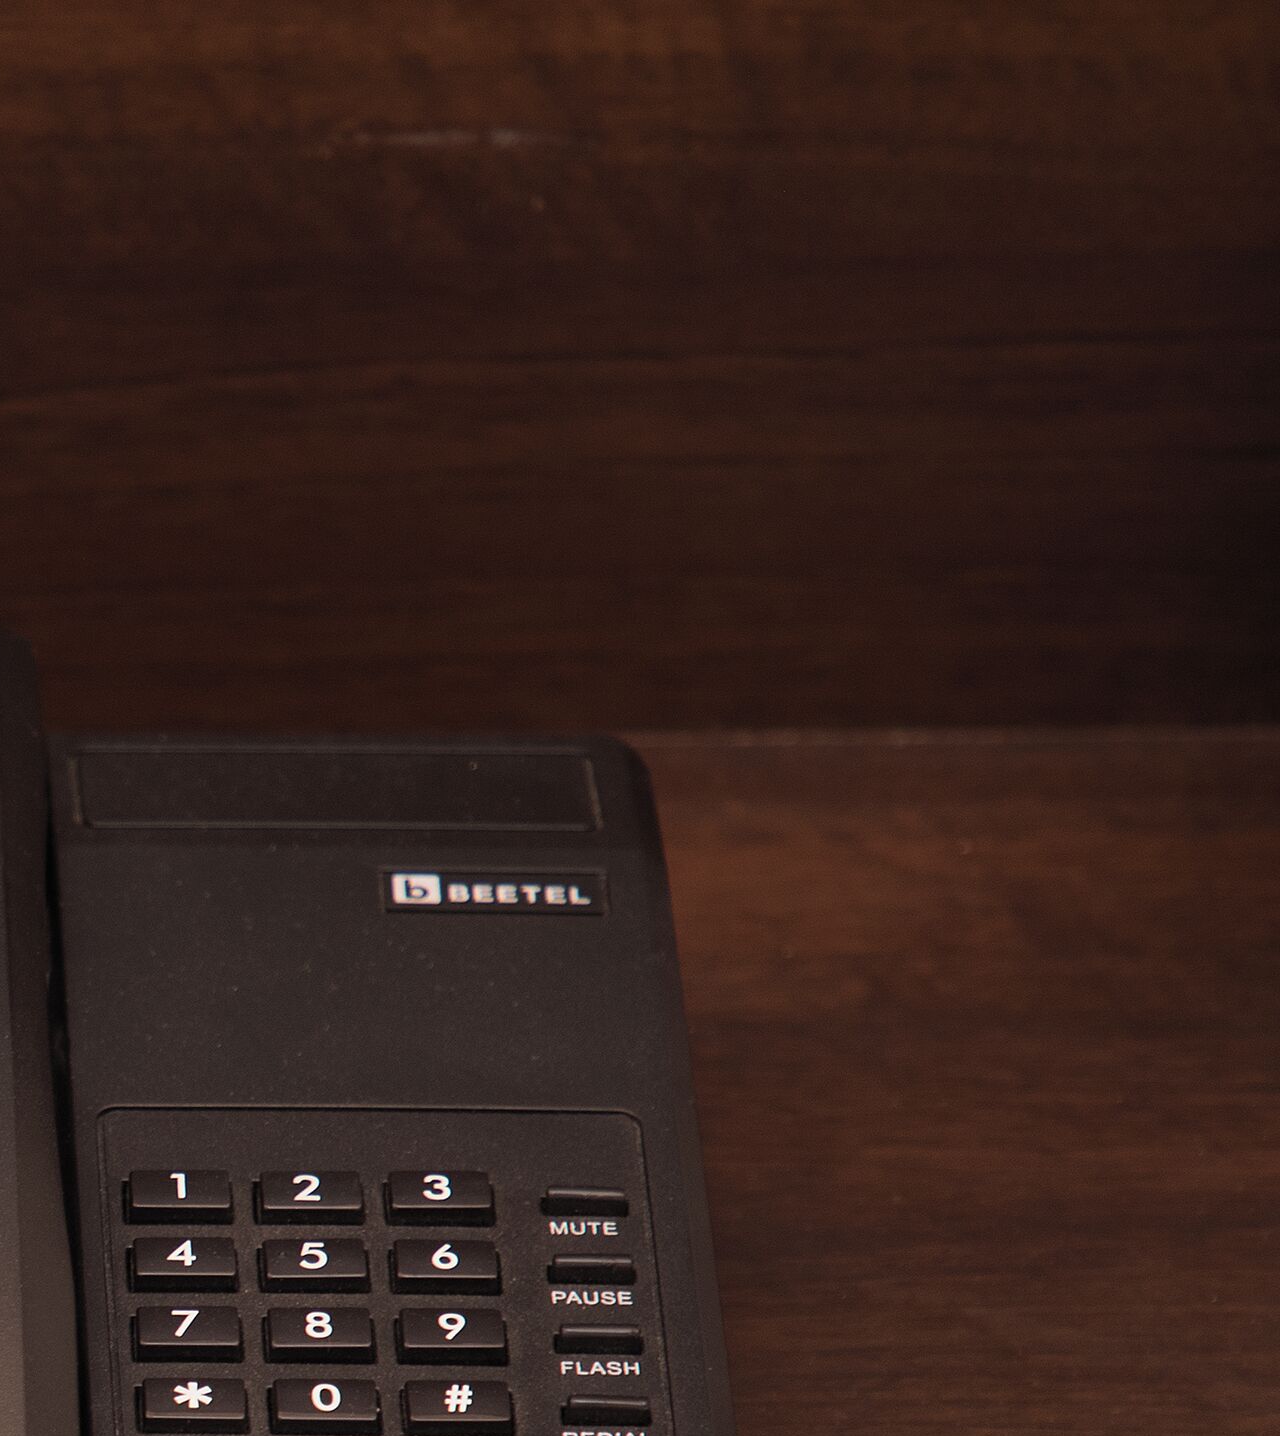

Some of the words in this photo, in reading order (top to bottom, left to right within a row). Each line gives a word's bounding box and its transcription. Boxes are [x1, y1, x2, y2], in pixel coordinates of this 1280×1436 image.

[447, 883, 591, 905] BEETEL
[169, 1172, 188, 1200] 1
[292, 1174, 322, 1202] 2
[422, 1173, 452, 1202] 3
[549, 1219, 619, 1237] MUTE
[165, 1240, 197, 1267] 4
[298, 1241, 329, 1270] 5
[430, 1243, 459, 1271] 6
[551, 1289, 634, 1307] PAUSE
[170, 1309, 200, 1337] 7
[304, 1311, 334, 1339] 8
[437, 1312, 467, 1341] 9
[559, 1360, 641, 1377] FLASH
[310, 1383, 341, 1412] 0
[443, 1383, 474, 1413] #
